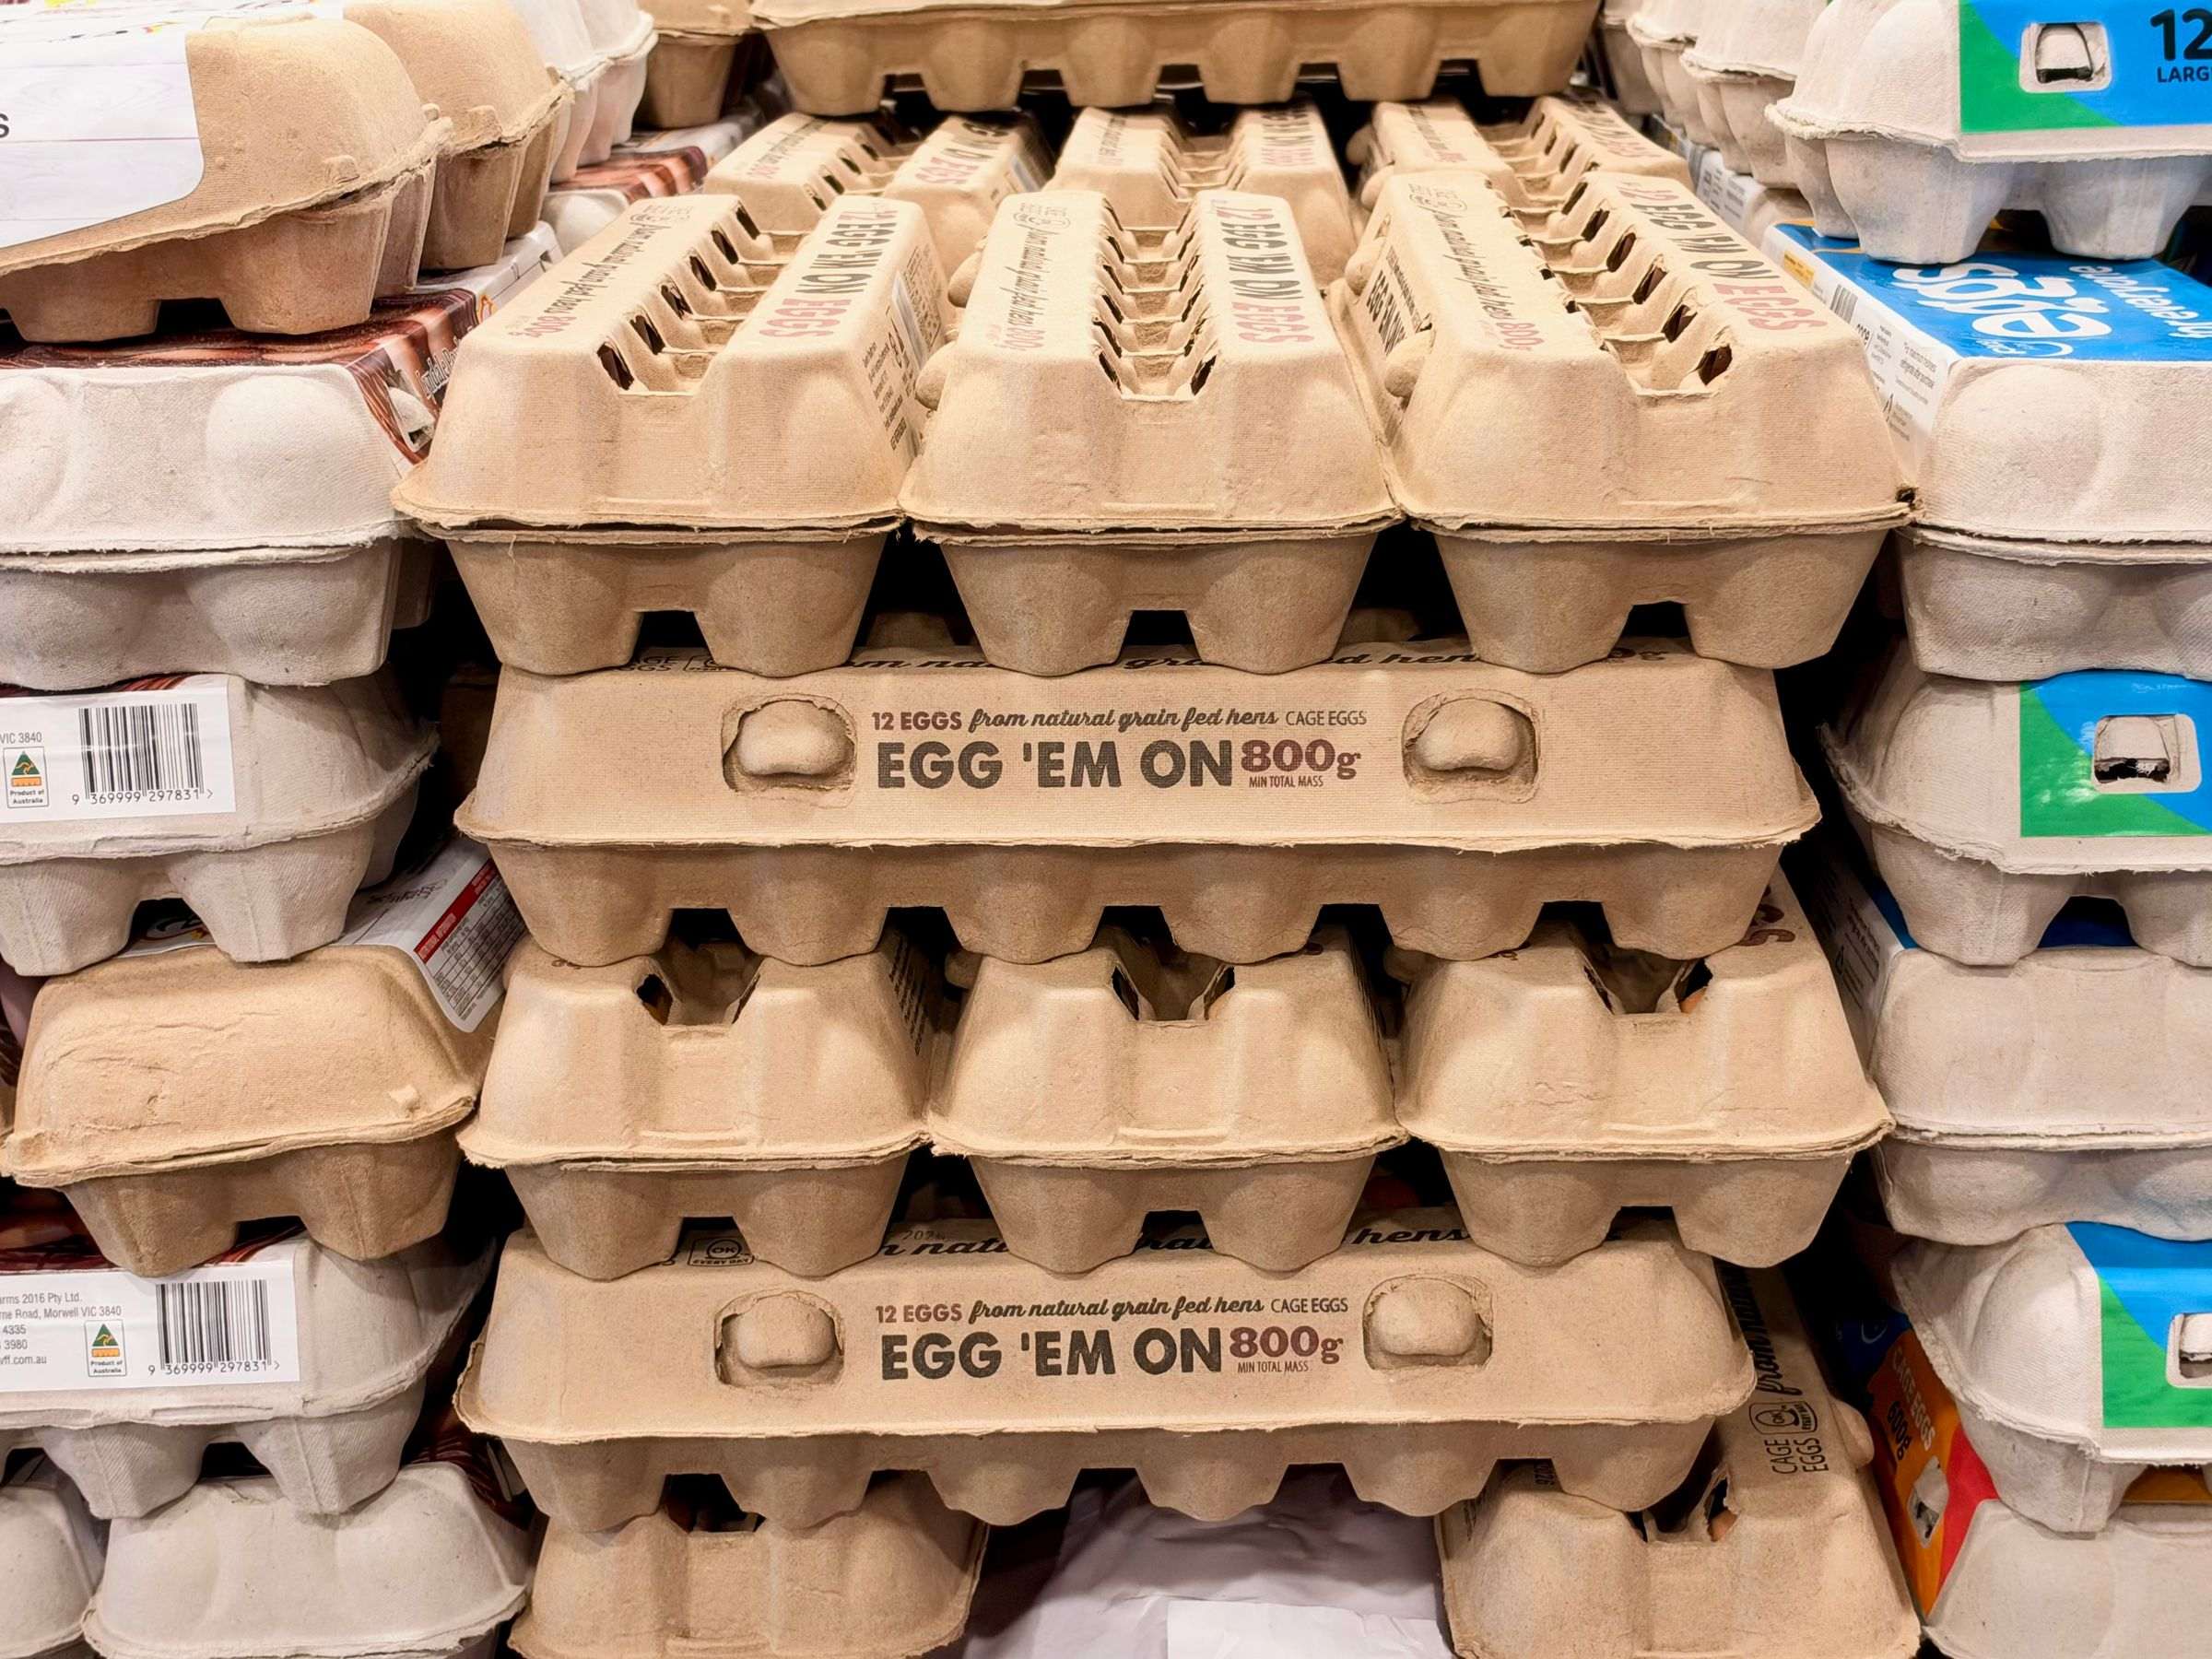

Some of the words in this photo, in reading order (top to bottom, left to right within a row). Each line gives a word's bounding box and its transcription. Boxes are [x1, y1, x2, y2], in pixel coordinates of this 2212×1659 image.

[2150, 8, 2212, 61] 12
[2158, 66, 2212, 83] LARG
[1217, 206, 1274, 221] 12
[1630, 204, 1717, 231] EGG
[826, 222, 897, 247] EGG
[1220, 222, 1288, 250] EGG
[1689, 259, 1780, 280] ON
[795, 273, 872, 294] ON
[1230, 279, 1305, 300] ON
[1712, 284, 1829, 331] EGGS
[1892, 263, 2113, 338] eggs
[759, 299, 852, 337] EGGS
[1232, 301, 1315, 344] EGGS
[872, 712, 895, 731] 12
[900, 711, 962, 730] EGGS
[969, 708, 1029, 732] from
[1031, 708, 1114, 728] natural
[1118, 708, 1180, 732] grain
[1180, 707, 1223, 732] fed
[1226, 707, 1279, 725] hens
[1286, 711, 1325, 726] CAGE
[1328, 710, 1368, 726] EGGS
[18, 732, 42, 743] 3840
[877, 741, 1003, 790] EGG
[1023, 740, 1122, 788] 'EM
[1140, 739, 1233, 789] ON
[1241, 739, 1361, 780] 800g
[1249, 776, 1268, 788] MIN
[1269, 776, 1295, 788] TOTAL
[1298, 775, 1324, 788] MASS
[72, 794, 79, 805] 9
[90, 791, 141, 805] 369999
[148, 789, 201, 801] 297831
[1352, 1228, 1472, 1244] hens
[712, 1246, 736, 1254] OK
[22, 1293, 45, 1304] 2016
[48, 1292, 63, 1305] Pty
[15, 1308, 41, 1321] Road,
[44, 1306, 79, 1319] Morwell
[81, 1306, 97, 1317] VIC
[99, 1305, 122, 1316] 3840
[876, 1305, 897, 1324] 12
[903, 1302, 962, 1323] EGGS
[969, 1300, 1028, 1324] from
[1030, 1298, 1109, 1318] natural
[1112, 1297, 1171, 1322] grain
[1171, 1296, 1211, 1320] fed
[1213, 1296, 1265, 1313] hens
[1271, 1298, 1309, 1314] CAGE
[1311, 1297, 1348, 1313] EGGS
[3, 1324, 27, 1335] 4335
[4, 1339, 28, 1350] 3980
[881, 1331, 1003, 1380] EGG
[1021, 1329, 1115, 1377] 'EM
[1133, 1327, 1222, 1375] ON
[1229, 1325, 1344, 1364] 800g
[148, 1365, 156, 1375] 9
[165, 1361, 213, 1375] 369999
[219, 1360, 267, 1373] 297831
[1237, 1362, 1254, 1373] MIN
[1256, 1361, 1282, 1373] TOTAL
[1285, 1361, 1309, 1373] MASS
[1769, 1412, 1785, 1425] OK
[1910, 1392, 1937, 1452] EGGS
[1887, 1400, 1914, 1461] 600g
[1764, 1439, 1798, 1475] CAGE
[1793, 1437, 1830, 1474] EGGS
